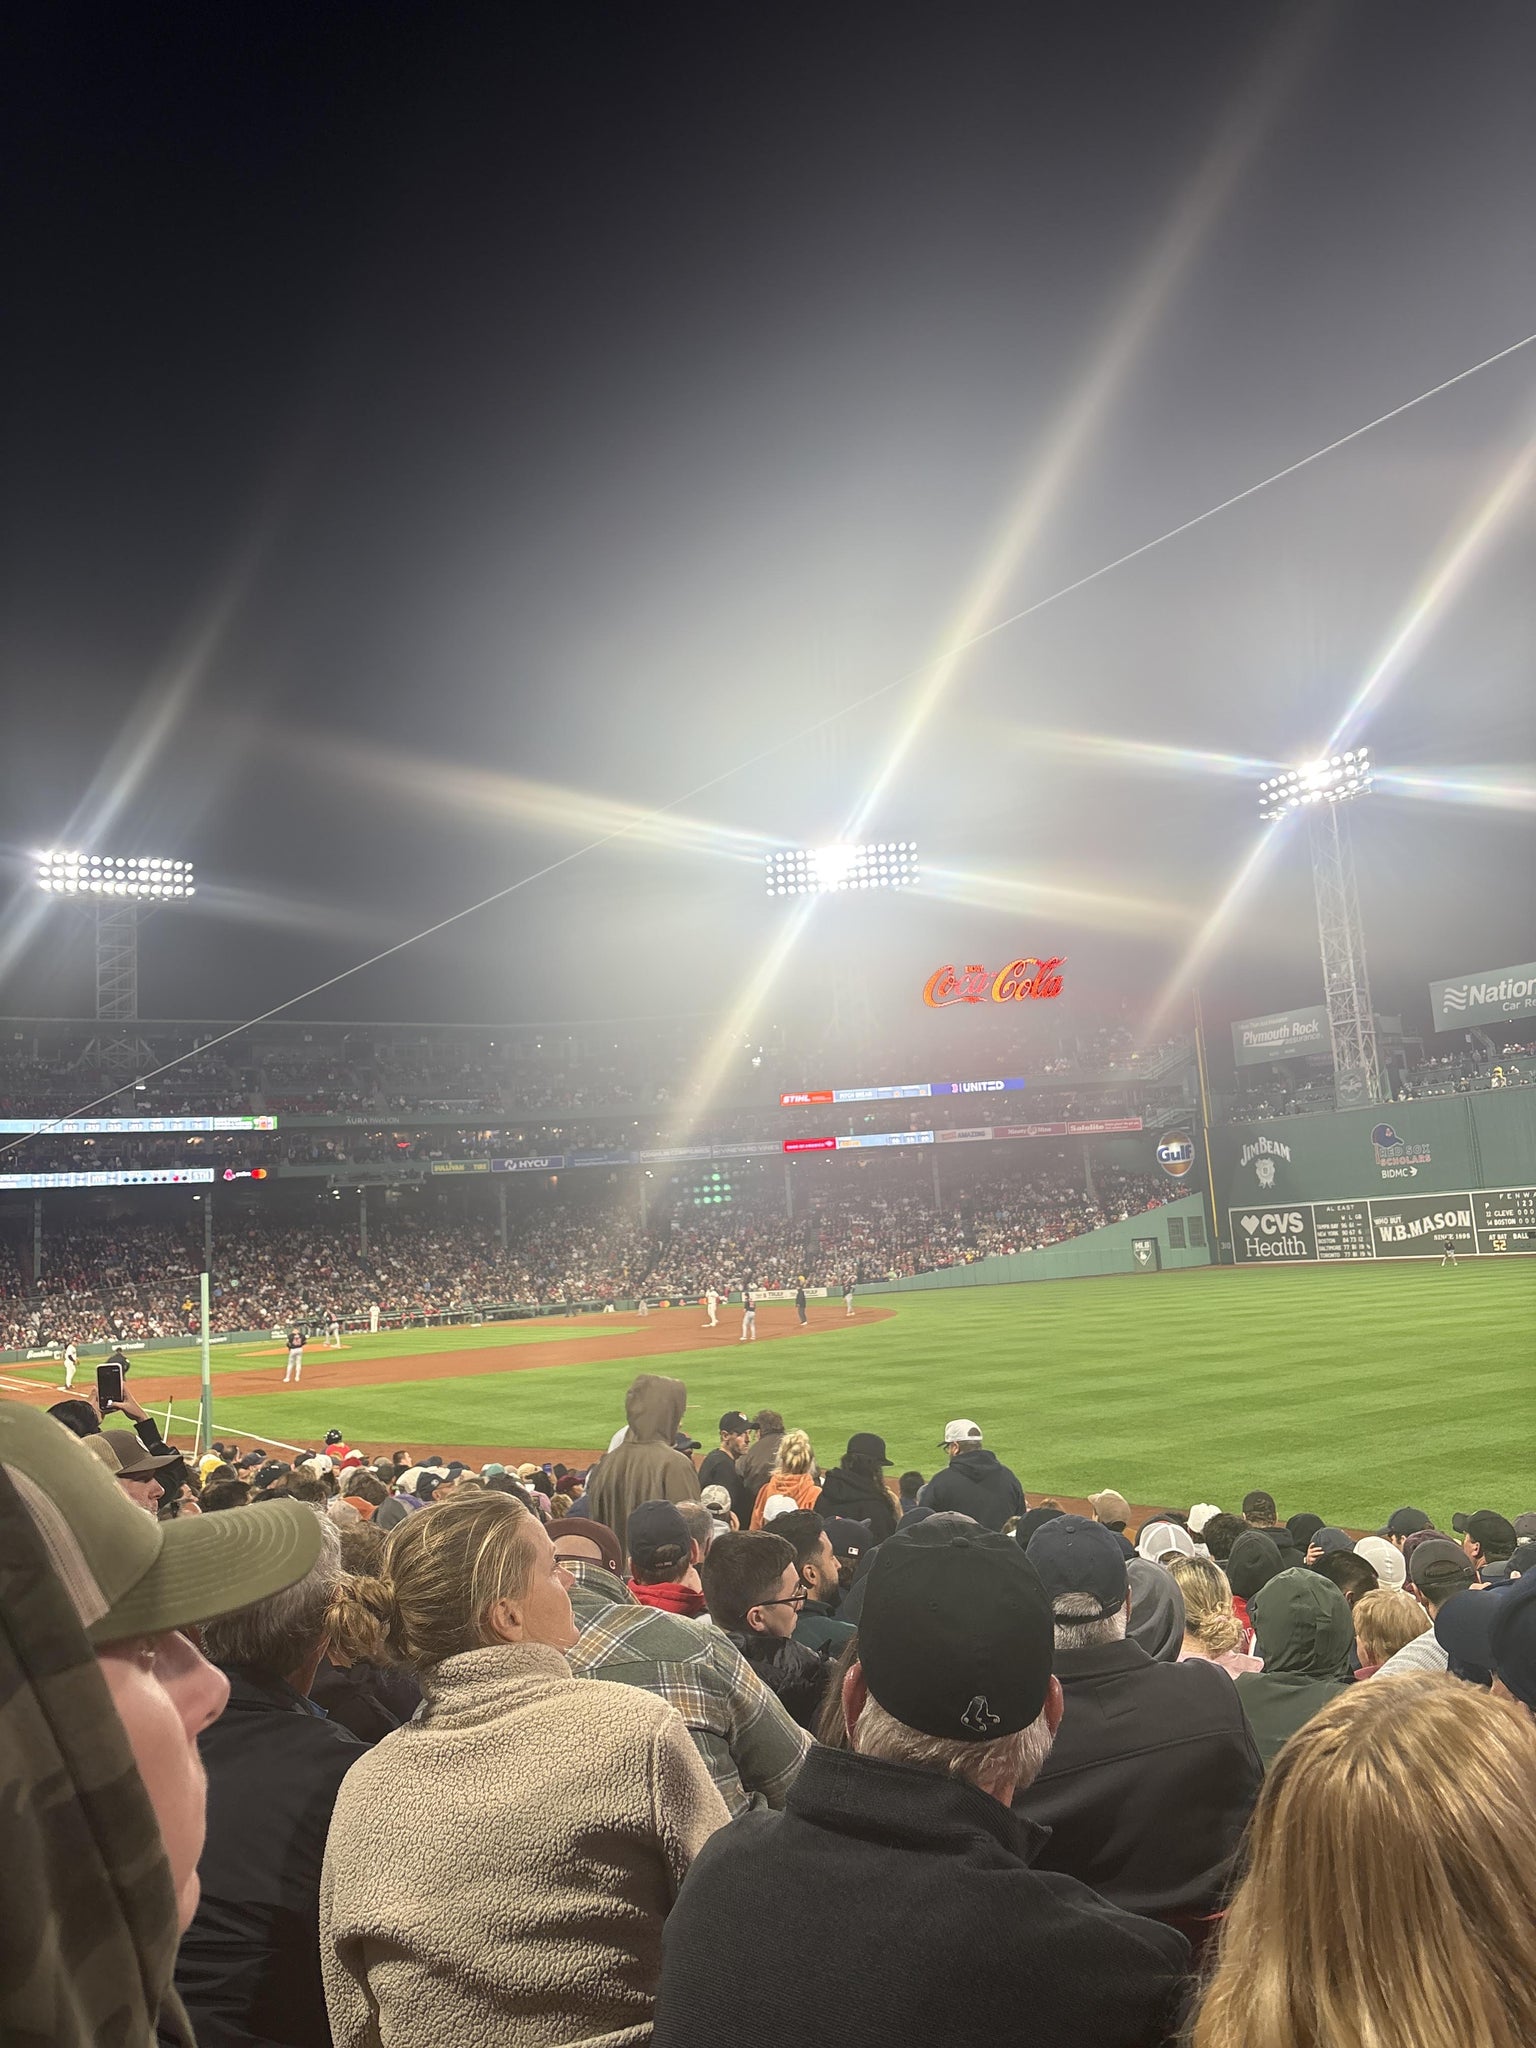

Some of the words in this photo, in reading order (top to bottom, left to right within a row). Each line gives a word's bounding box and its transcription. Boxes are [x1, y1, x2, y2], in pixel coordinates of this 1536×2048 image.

[923, 956, 1067, 1008] Coca-Cola
[1502, 1001, 1521, 1012] Car
[1243, 1025, 1290, 1046] Plymouth
[1292, 1018, 1319, 1036] Rock
[1158, 1144, 1192, 1163] Gulf
[1241, 1142, 1260, 1167] JIM
[1258, 1136, 1292, 1163] BEAM
[1380, 1146, 1403, 1157] RED
[1406, 1143, 1431, 1155] SOX
[519, 1159, 549, 1168] HYCU
[1380, 1154, 1431, 1166] SCHOLARS
[1381, 1168, 1409, 1179] BIDMC
[1261, 1212, 1304, 1235] CVS
[1374, 1216, 1389, 1225] WHO
[1389, 1216, 1402, 1224] BUT
[1494, 1218, 1517, 1226] BOSTON
[1512, 1232, 1529, 1240] BALL
[1135, 1241, 1150, 1250] MLB
[1221, 1241, 1231, 1250] 310
[1245, 1236, 1308, 1257] Health
